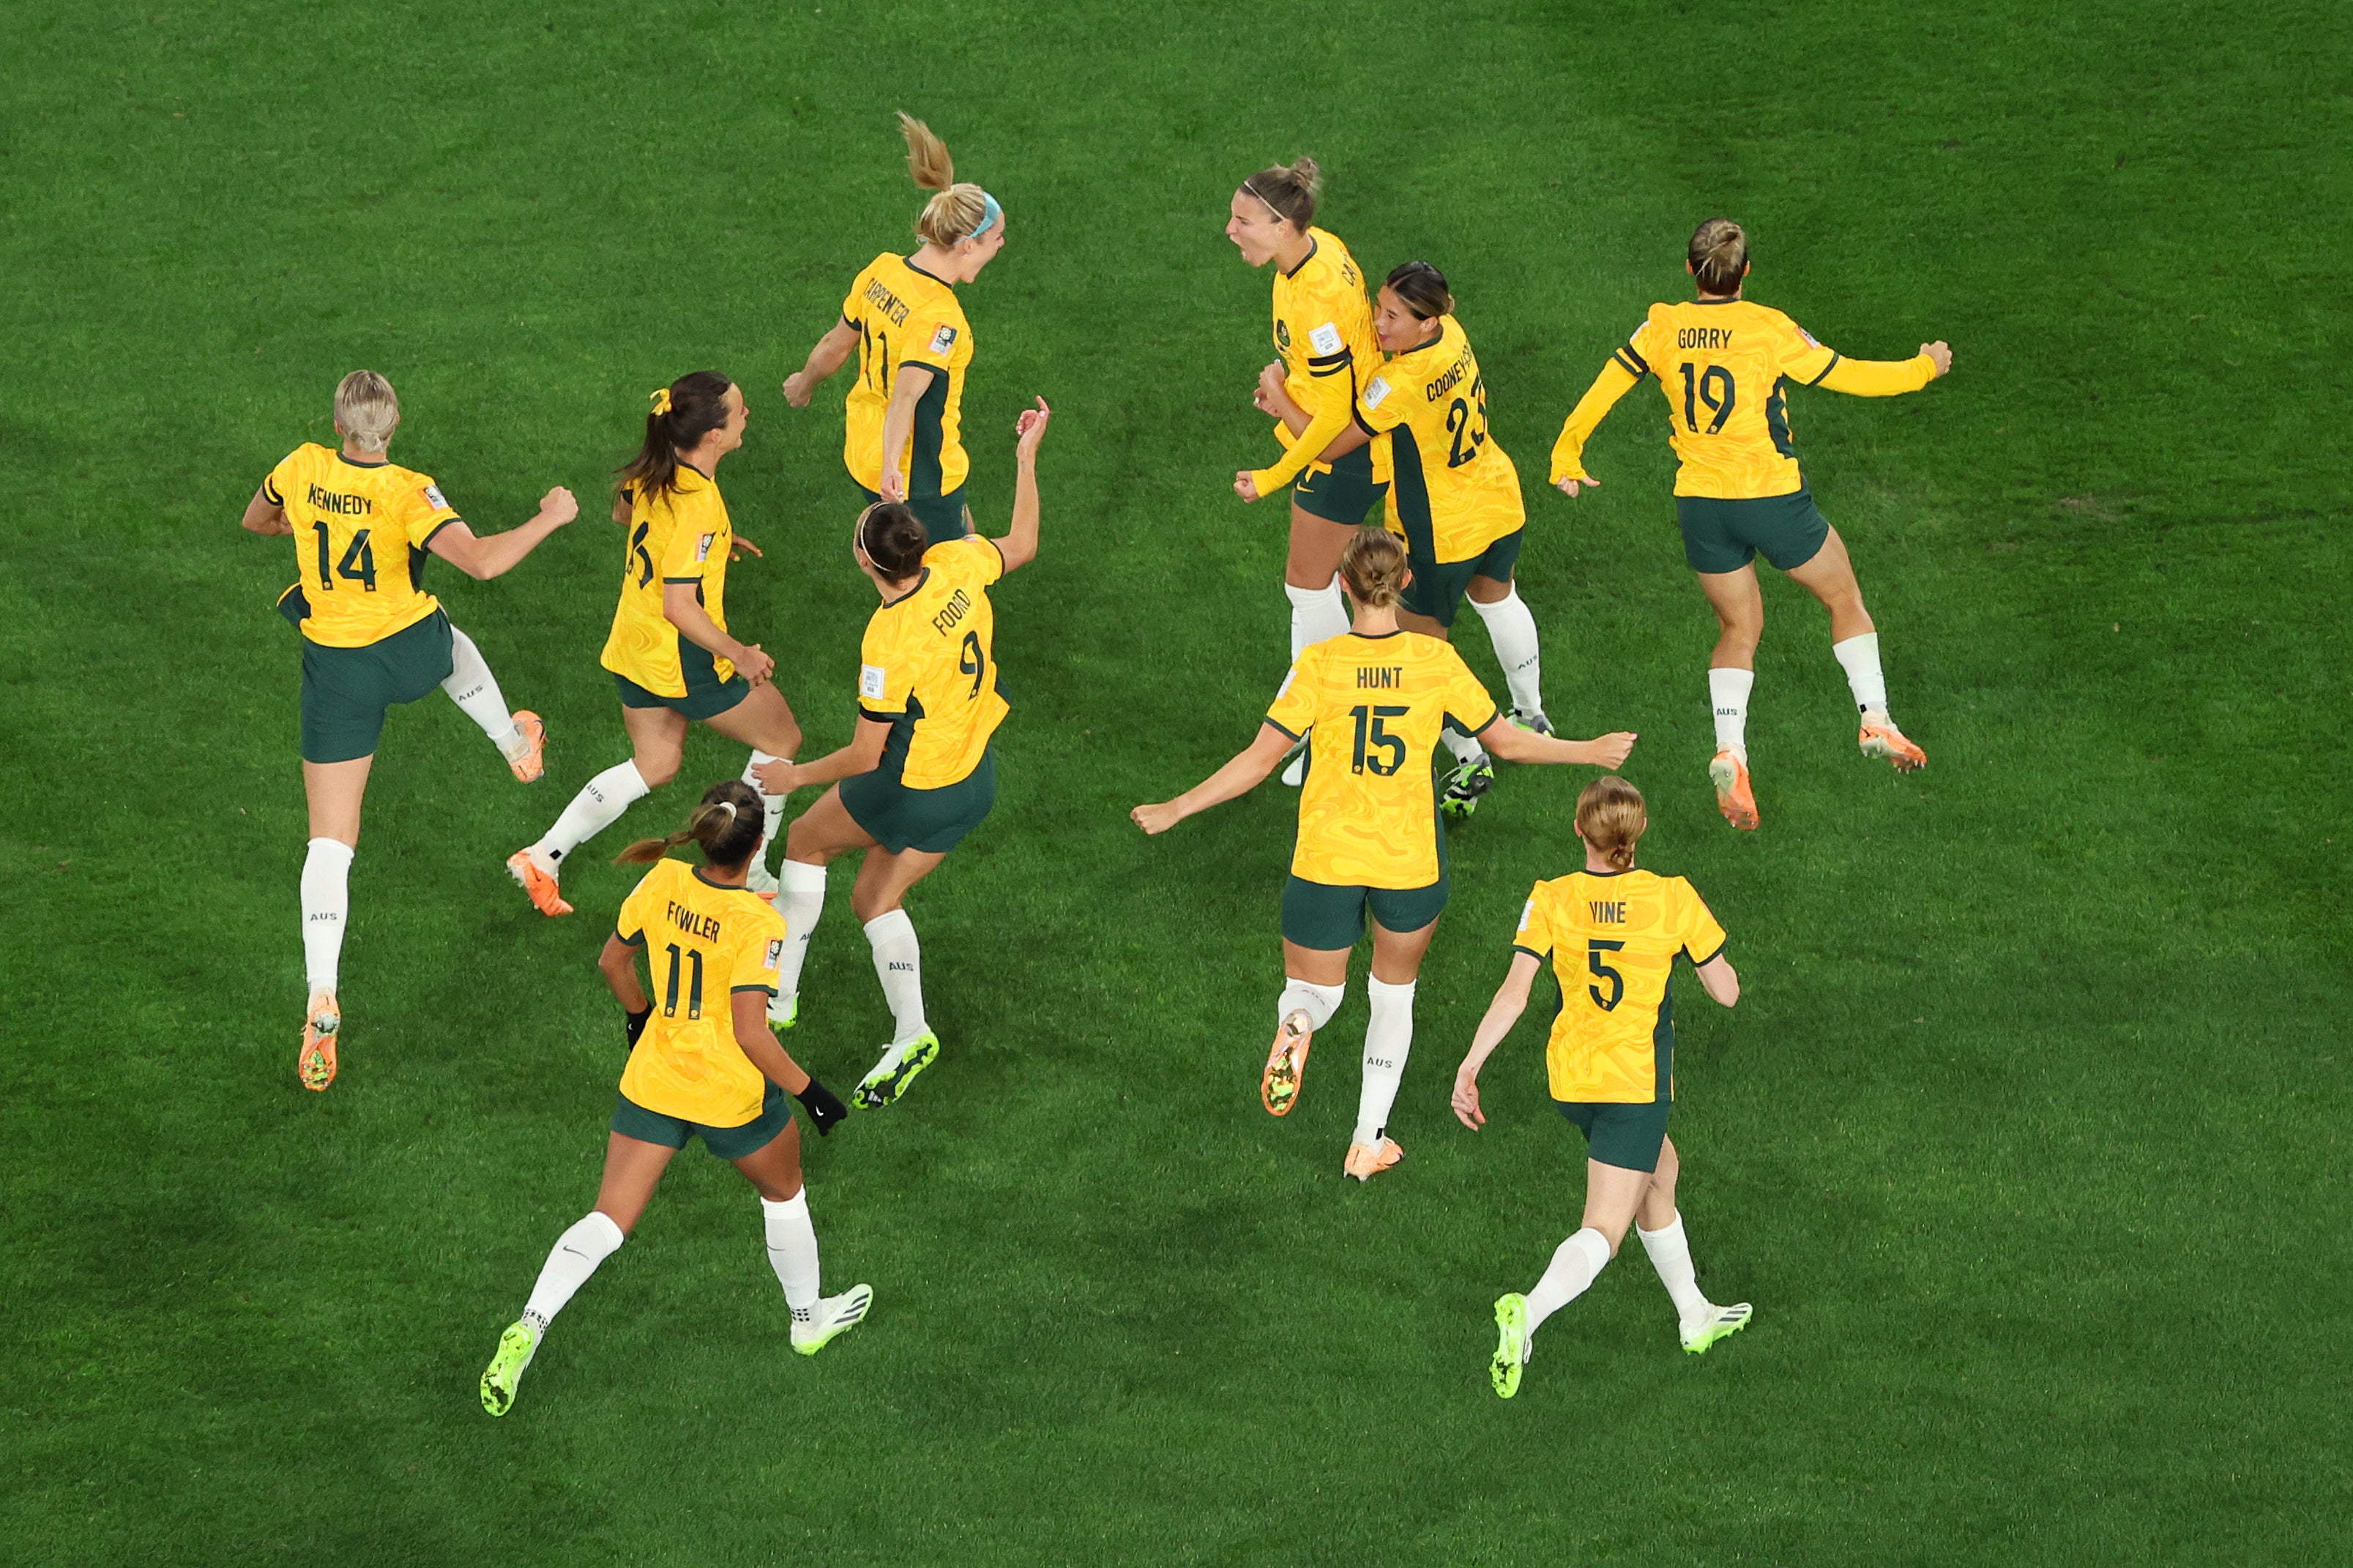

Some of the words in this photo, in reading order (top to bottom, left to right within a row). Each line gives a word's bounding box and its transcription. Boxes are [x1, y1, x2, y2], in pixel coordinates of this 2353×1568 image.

[1678, 328, 1733, 349] GORRY
[1679, 362, 1735, 435] 19
[307, 482, 372, 515] KENNEDY
[312, 520, 378, 592] 14
[932, 589, 972, 637] FOORD
[960, 630, 985, 701] 9
[1356, 667, 1403, 689] HUNT
[458, 684, 483, 701] AUS
[1716, 708, 1737, 716] AUS
[1349, 705, 1411, 777] 15
[586, 783, 604, 803] AUS
[310, 912, 338, 922] AUS
[667, 900, 720, 944] FOWLER
[1589, 901, 1626, 924] VINE
[665, 942, 702, 1020] 11
[889, 962, 914, 972] AUS
[1588, 939, 1625, 1012] 5
[1367, 1056, 1392, 1069] AUS
